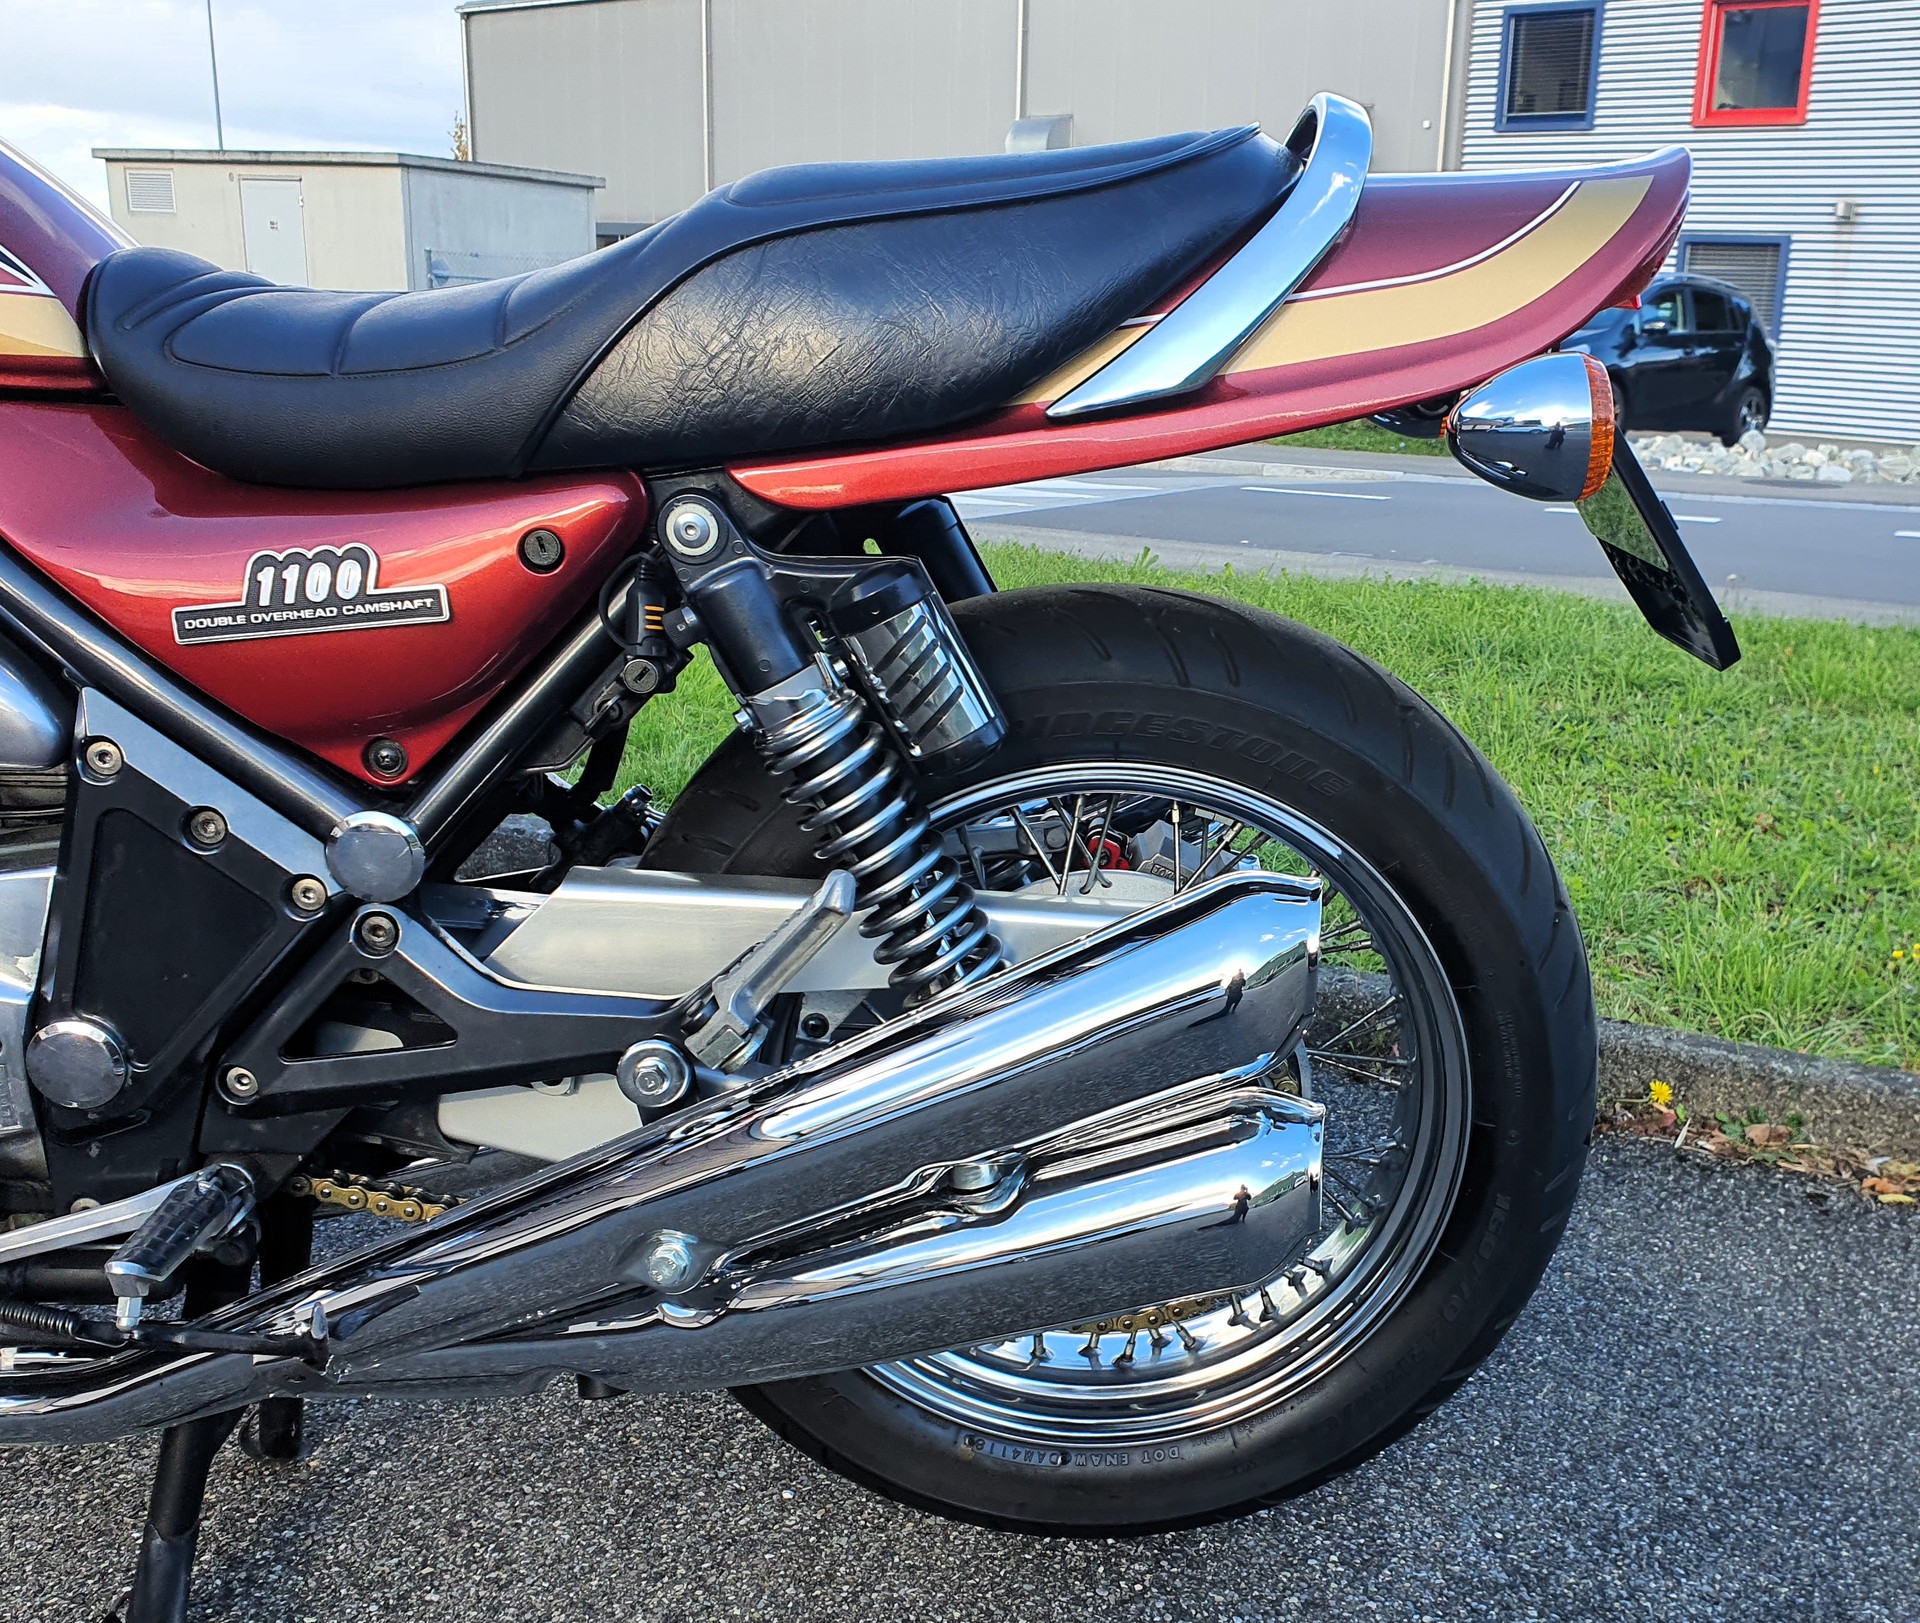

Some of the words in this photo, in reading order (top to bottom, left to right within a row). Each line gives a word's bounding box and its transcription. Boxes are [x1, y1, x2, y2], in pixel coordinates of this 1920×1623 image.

[256, 559, 362, 607] 1100
[184, 614, 247, 630] DOUBLE
[250, 606, 338, 624] OVERHEAD
[342, 598, 434, 616] CAMSHAFT
[1012, 709, 1353, 797] IDGESTONE
[1075, 1452, 1129, 1467] ENAW
[1142, 1446, 1180, 1463] DOT
